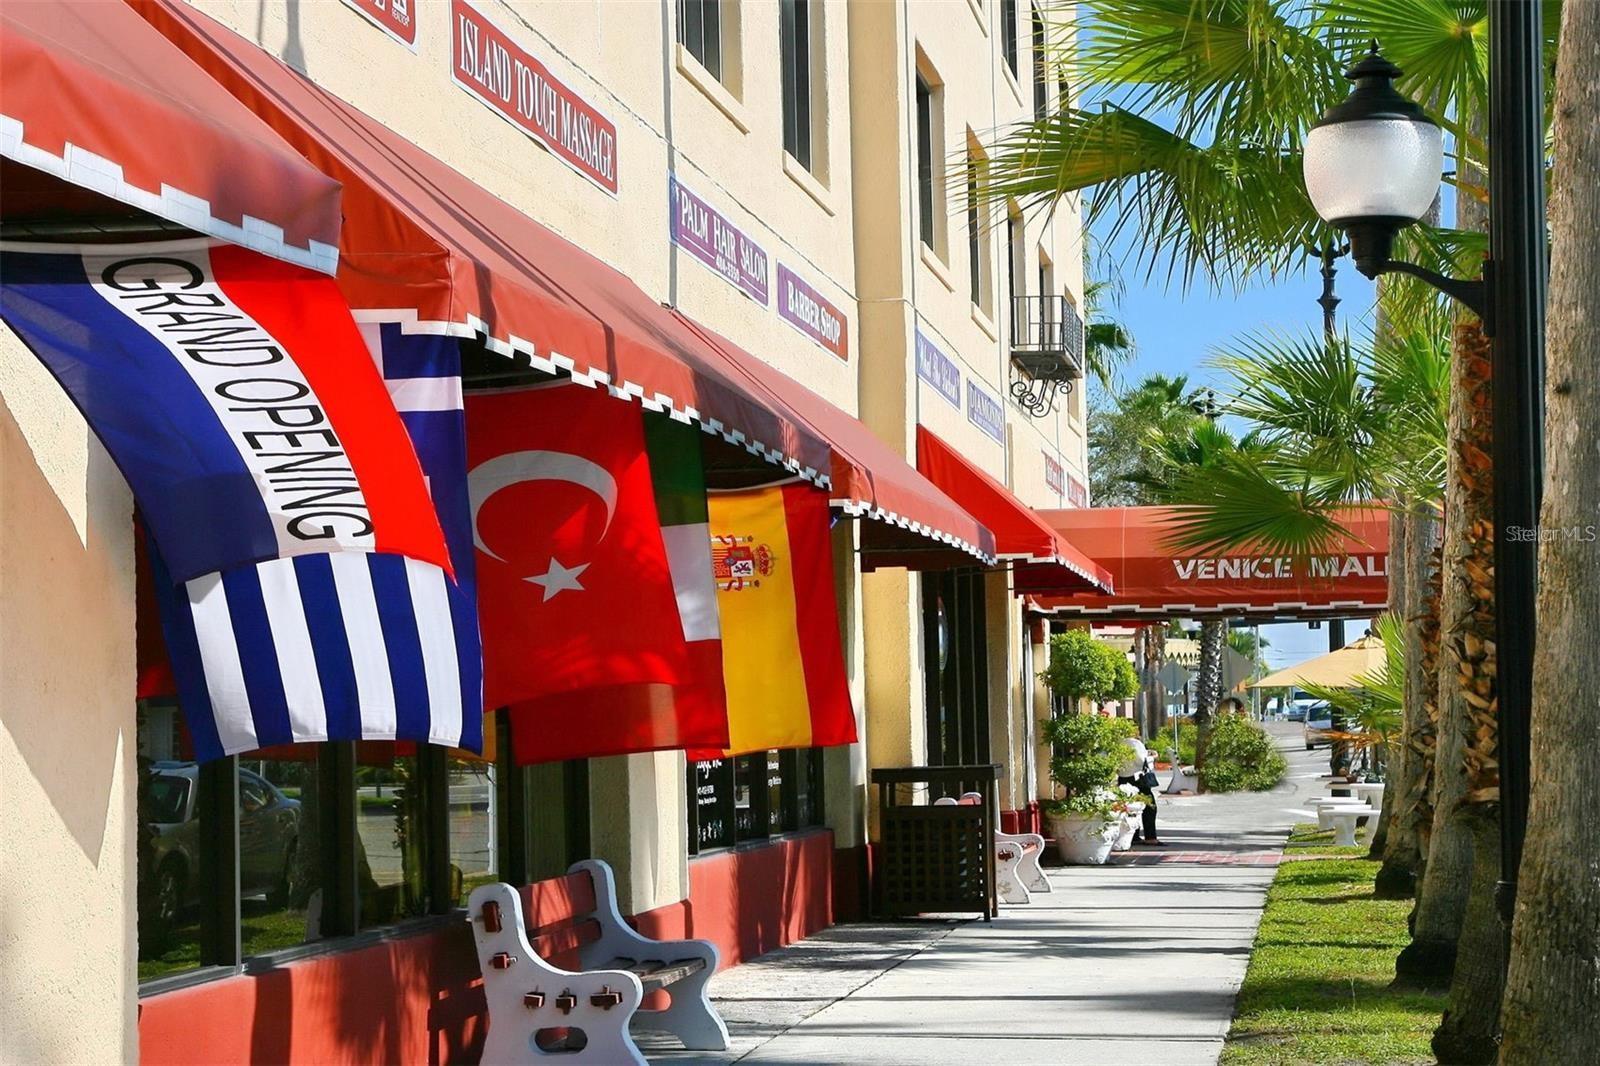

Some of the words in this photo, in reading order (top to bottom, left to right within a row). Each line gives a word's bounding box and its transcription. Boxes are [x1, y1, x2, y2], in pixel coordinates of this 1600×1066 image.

[459, 13, 512, 103] ISLAND
[514, 59, 558, 141] TOUCH
[560, 96, 614, 182] MASSAGE
[681, 191, 709, 244] PALM
[713, 215, 737, 264] HAIR
[740, 237, 766, 286] SALON
[787, 281, 820, 331] BARBER
[820, 307, 841, 346] SHOP
[102, 257, 284, 367] GRAND
[214, 378, 374, 541] OPENING
[1172, 558, 1292, 579] VENICE
[1308, 556, 1388, 578] MAL
